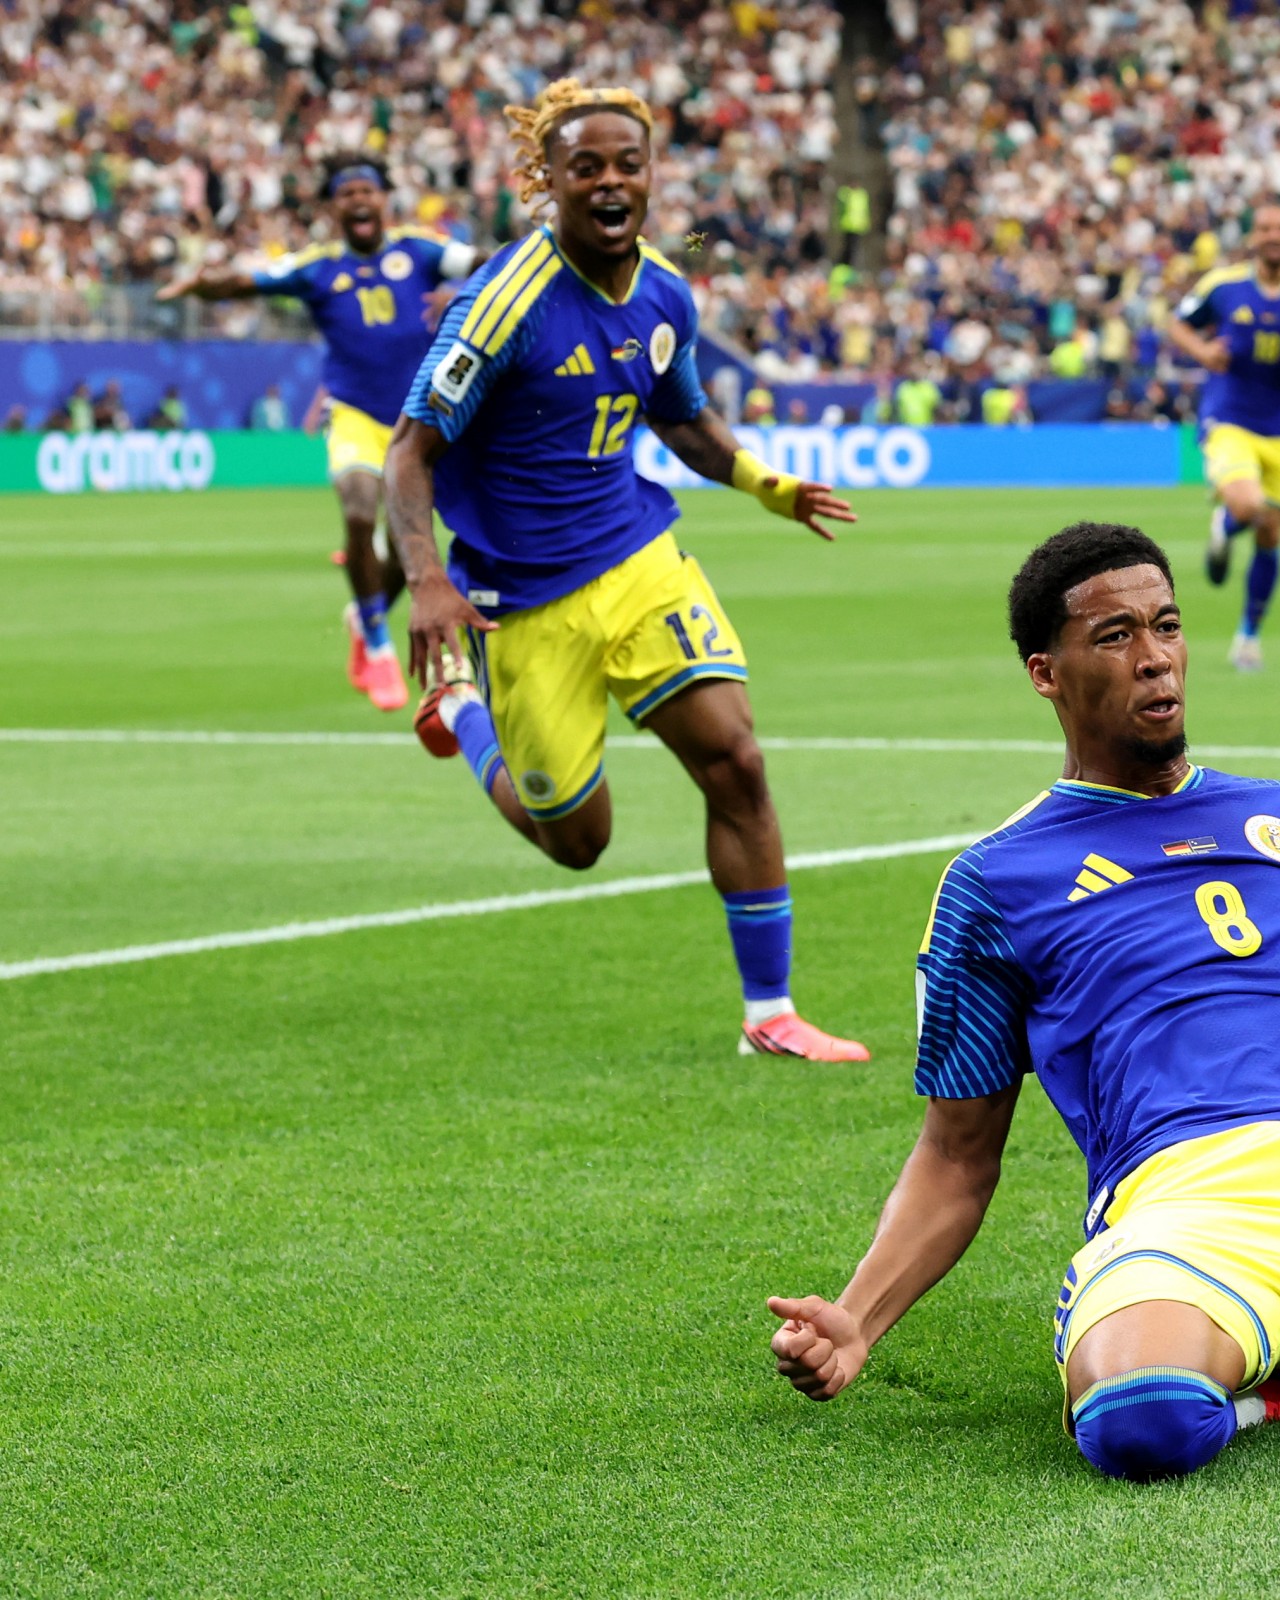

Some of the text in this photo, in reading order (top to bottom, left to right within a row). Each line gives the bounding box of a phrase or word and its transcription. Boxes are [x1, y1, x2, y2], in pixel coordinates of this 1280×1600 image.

[355, 285, 396, 327] 10
[587, 393, 638, 458] 12
[633, 426, 931, 487] amco
[36, 429, 215, 492] aramco
[665, 604, 733, 660] 12
[1195, 880, 1263, 957] 8
